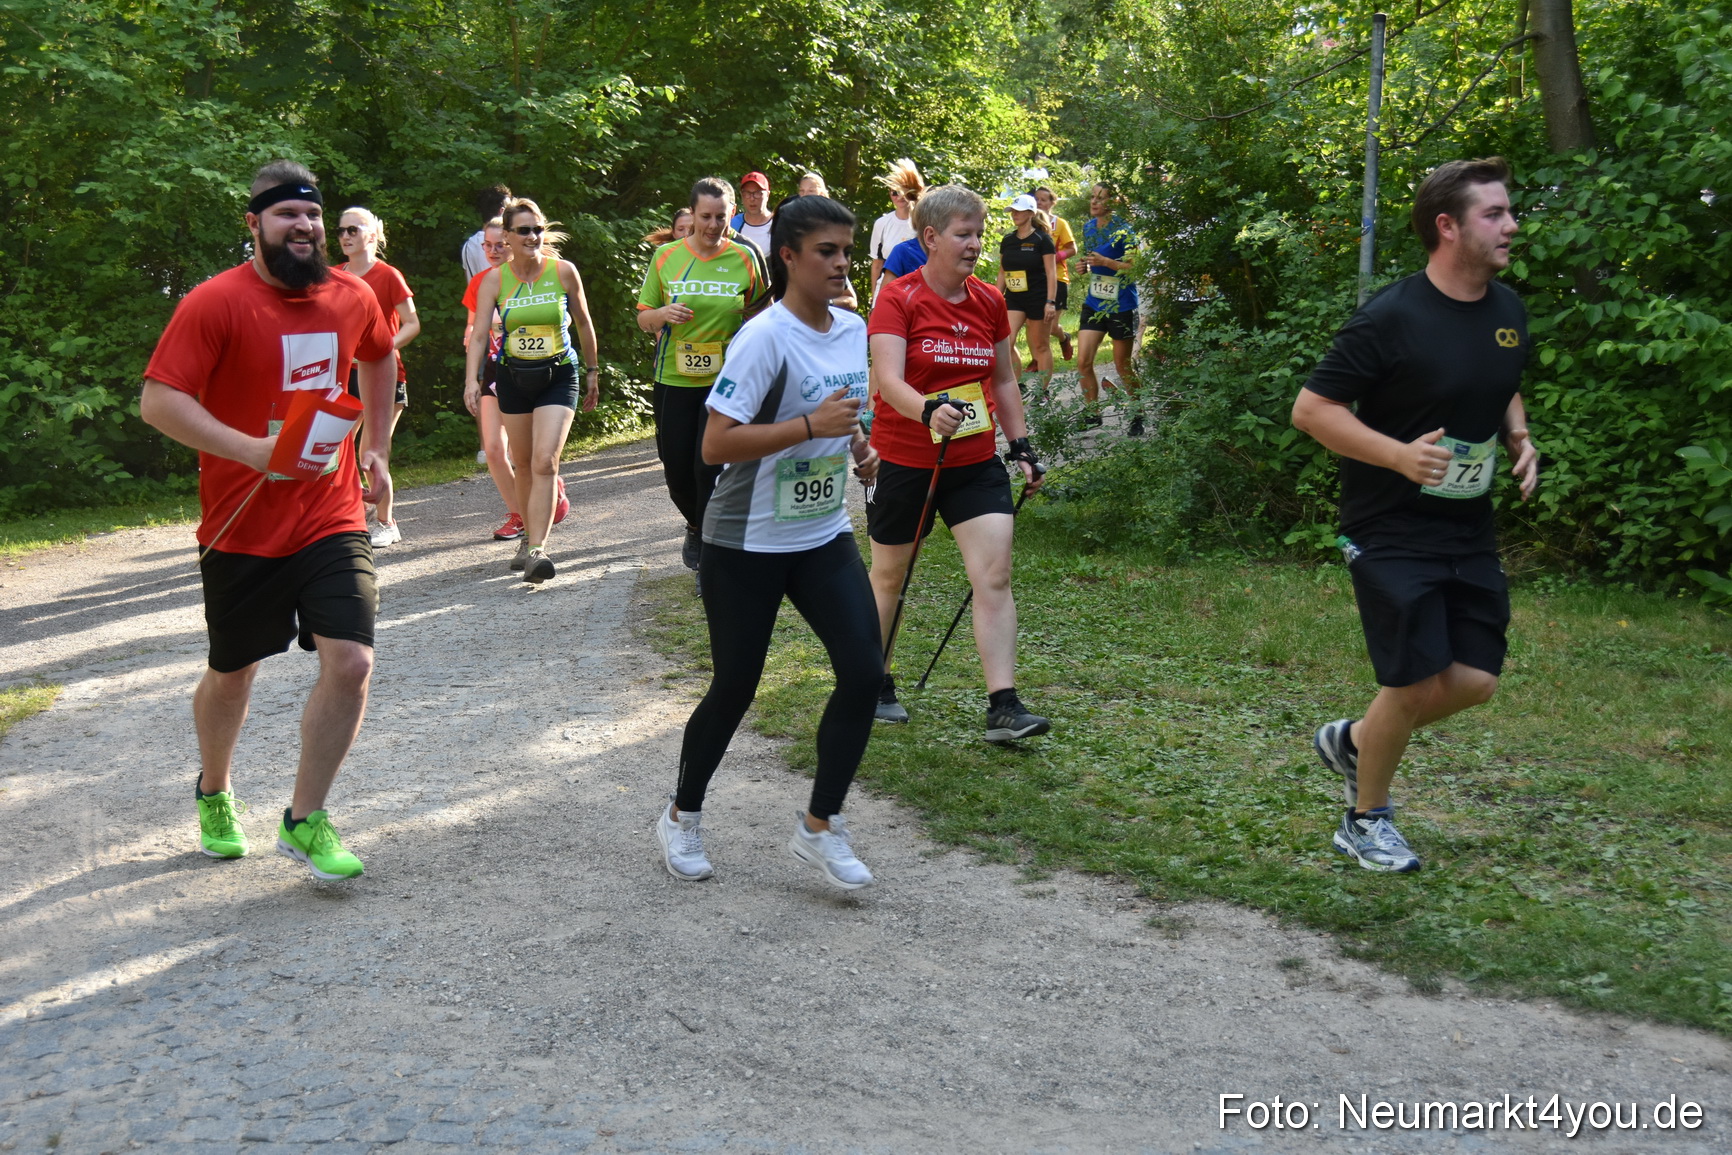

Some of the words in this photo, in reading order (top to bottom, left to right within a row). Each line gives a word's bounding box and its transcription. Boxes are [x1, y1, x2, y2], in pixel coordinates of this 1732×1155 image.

[668, 279, 740, 297] BOCK
[1008, 278, 1021, 287] 132
[1093, 282, 1115, 294] 1142
[505, 292, 558, 309] BOCK
[518, 337, 545, 351] 322
[921, 338, 954, 355] Echtes
[685, 354, 712, 368] 329
[934, 355, 960, 364] IMMER
[962, 357, 989, 367] FRISCH
[301, 365, 321, 378] DEHN
[297, 460, 320, 472] DEHN
[1455, 462, 1484, 483] 72
[794, 476, 835, 503] 996
